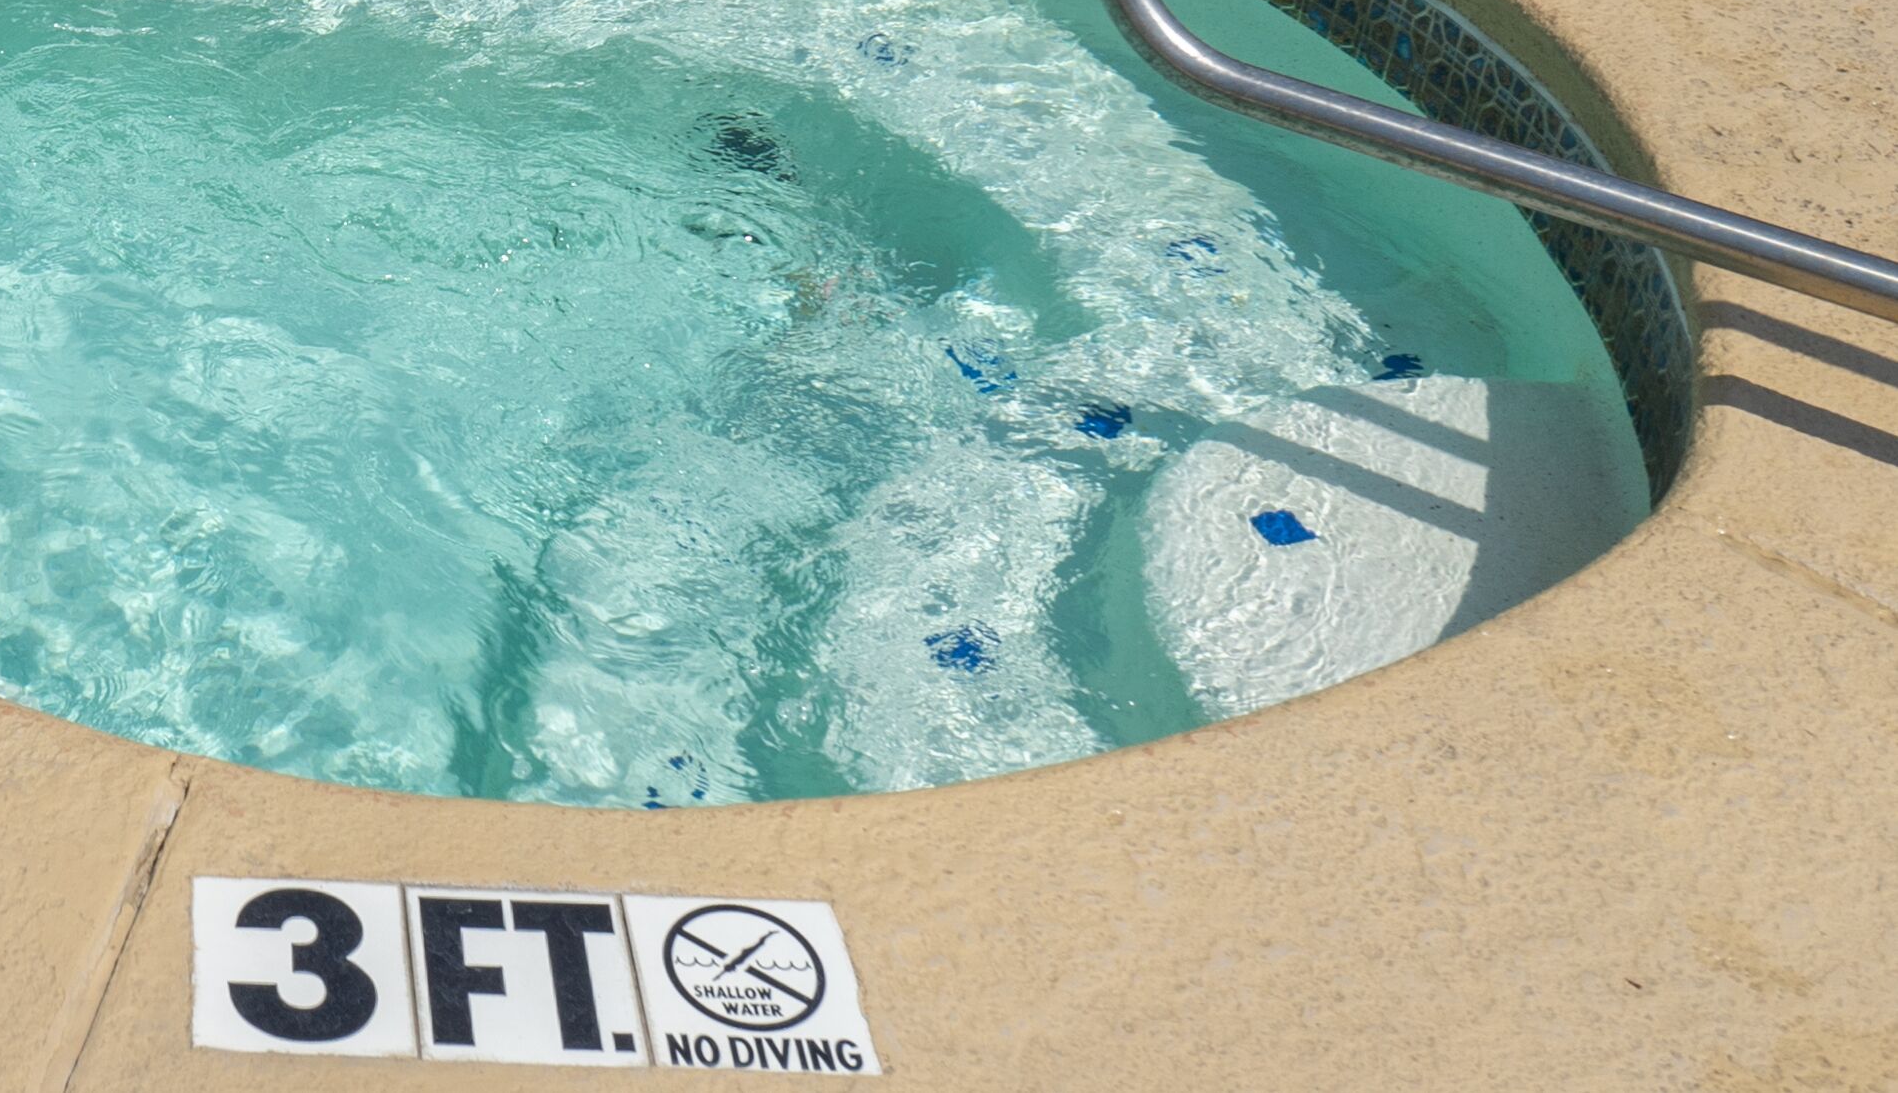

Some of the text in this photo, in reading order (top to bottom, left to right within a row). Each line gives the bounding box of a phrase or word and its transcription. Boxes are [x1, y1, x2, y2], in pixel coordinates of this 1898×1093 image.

[227, 887, 637, 1054] 3 FT.
[693, 984, 773, 1001] SHALLOW
[722, 1001, 784, 1018] WATER
[665, 1032, 864, 1073] NO DIVING
